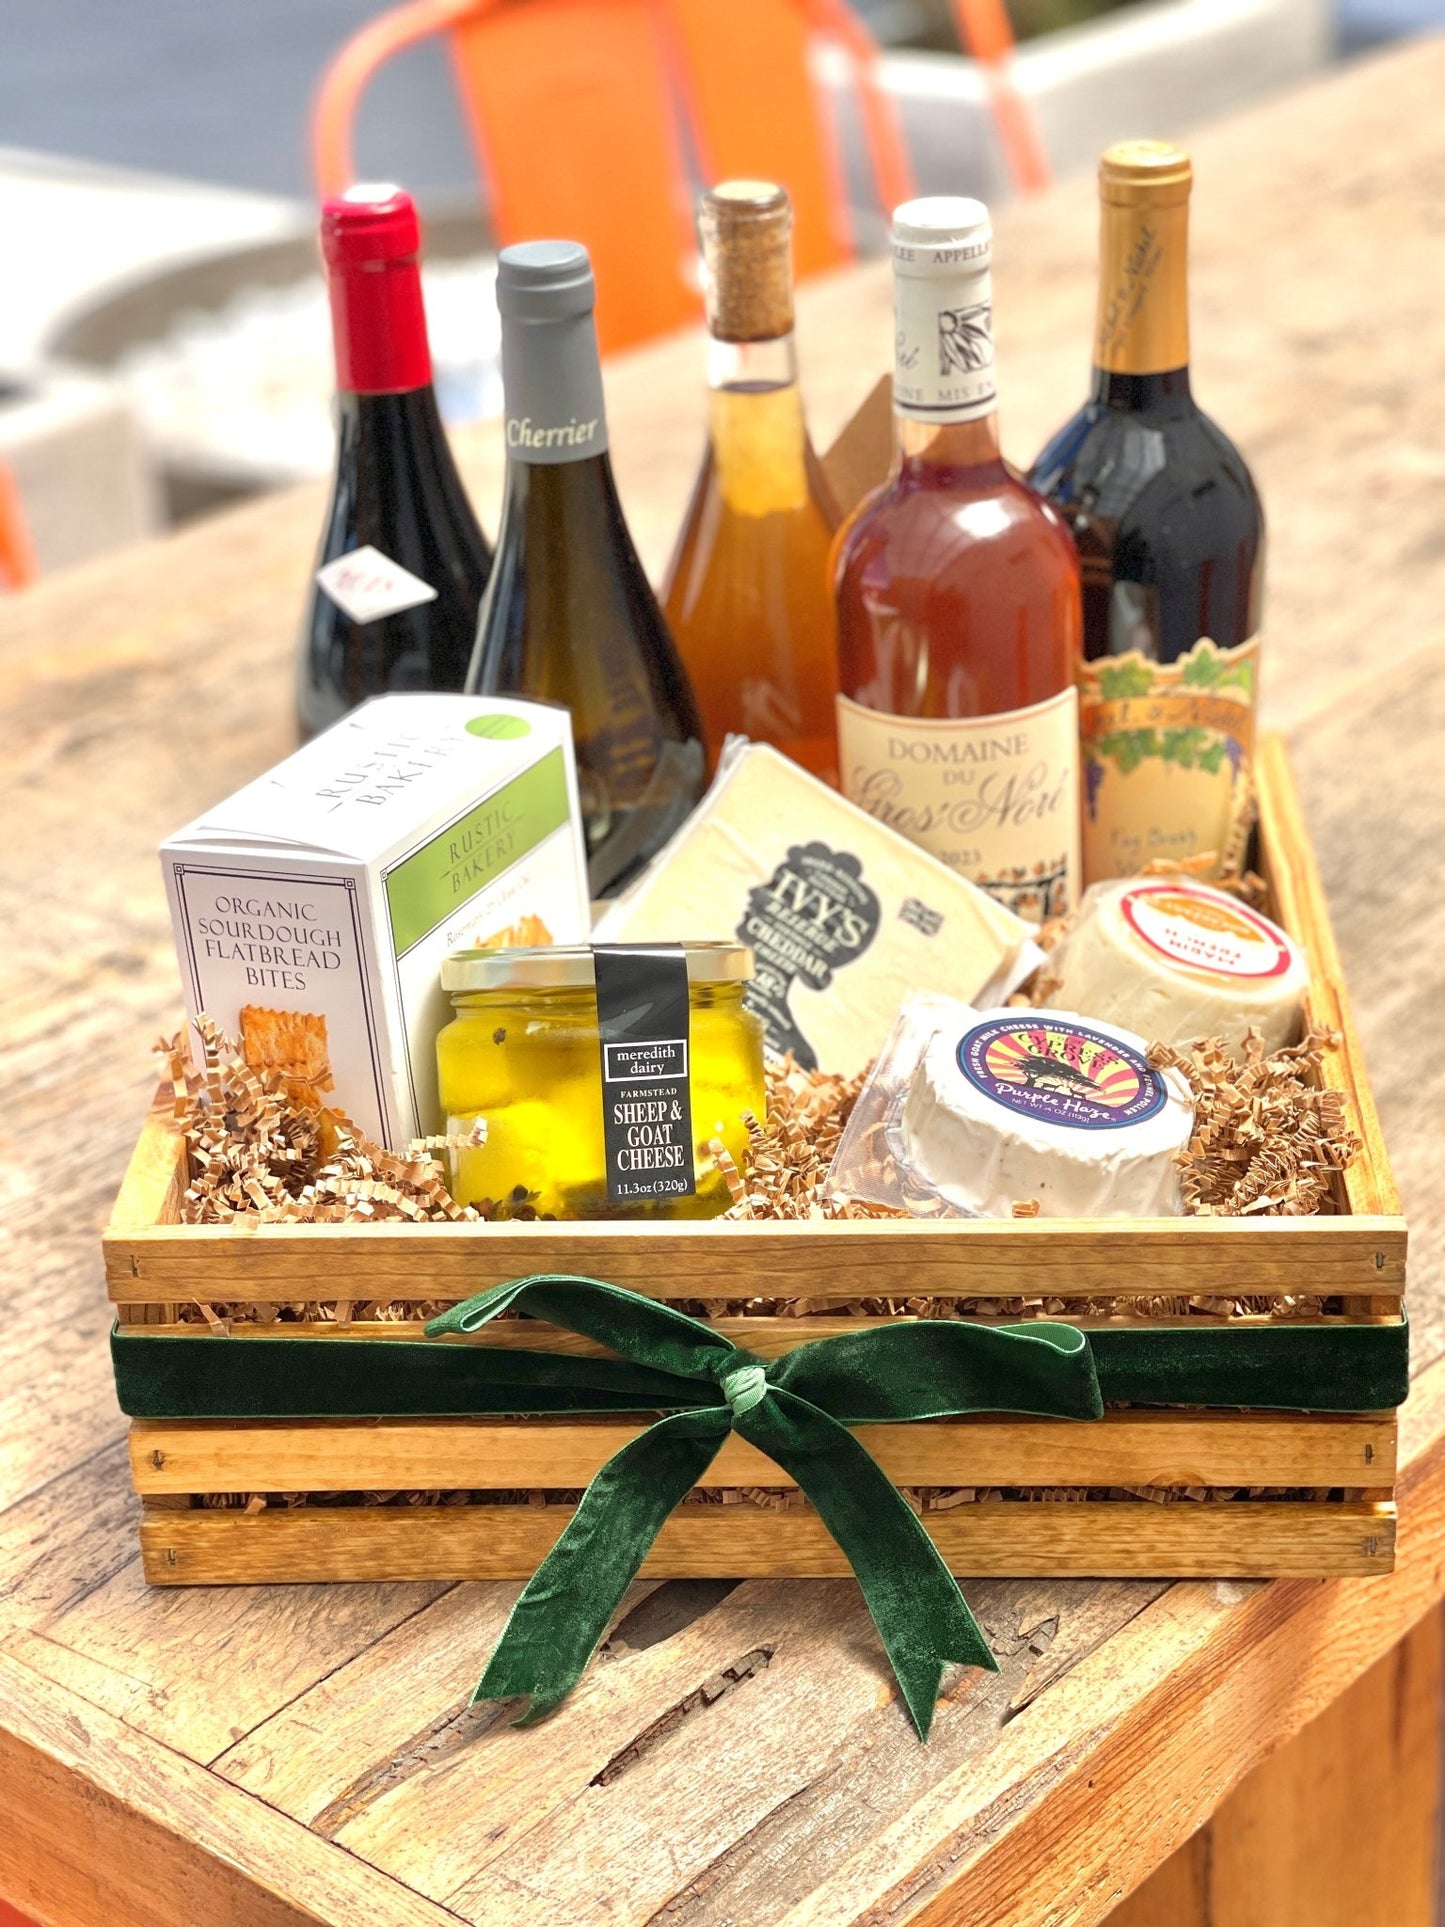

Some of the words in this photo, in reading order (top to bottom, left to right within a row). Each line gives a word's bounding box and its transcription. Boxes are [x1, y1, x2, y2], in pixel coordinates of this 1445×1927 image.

[506, 417, 599, 448] Cherrier
[887, 734, 1029, 763] DOMAINE
[942, 769, 976, 786] DU
[449, 801, 513, 864] RUSTIC
[452, 832, 514, 894] BAKERY
[215, 896, 318, 921] ORGANIC
[766, 867, 870, 949] IVY'S
[198, 918, 342, 947] SOURDOUGH
[205, 939, 341, 970] FLATBREAD
[746, 916, 829, 979] CHEDDAR
[246, 967, 306, 991] BITES
[979, 1028, 1000, 1042] MILK
[1000, 1023, 1039, 1032] CHEESE
[1043, 1024, 1073, 1035] WITH
[616, 1045, 677, 1062] meredith
[970, 1040, 984, 1057] GOAT
[1077, 1031, 1131, 1059] LAVENDER
[629, 1061, 665, 1076] dairy
[970, 1057, 989, 1079] FRESH
[1129, 1059, 1147, 1073] AND
[620, 1087, 678, 1099] FARMSTEAD
[995, 1082, 1059, 1106] Purple
[1062, 1098, 1112, 1120] Haze
[613, 1100, 668, 1125] SHEEP
[670, 1099, 683, 1121] &
[1123, 1097, 1152, 1116] POLLEN
[626, 1123, 674, 1148] GOAT
[616, 1145, 685, 1172] CHEESE
[616, 1181, 652, 1196] 11.3oz
[653, 1178, 689, 1194] (320g)
